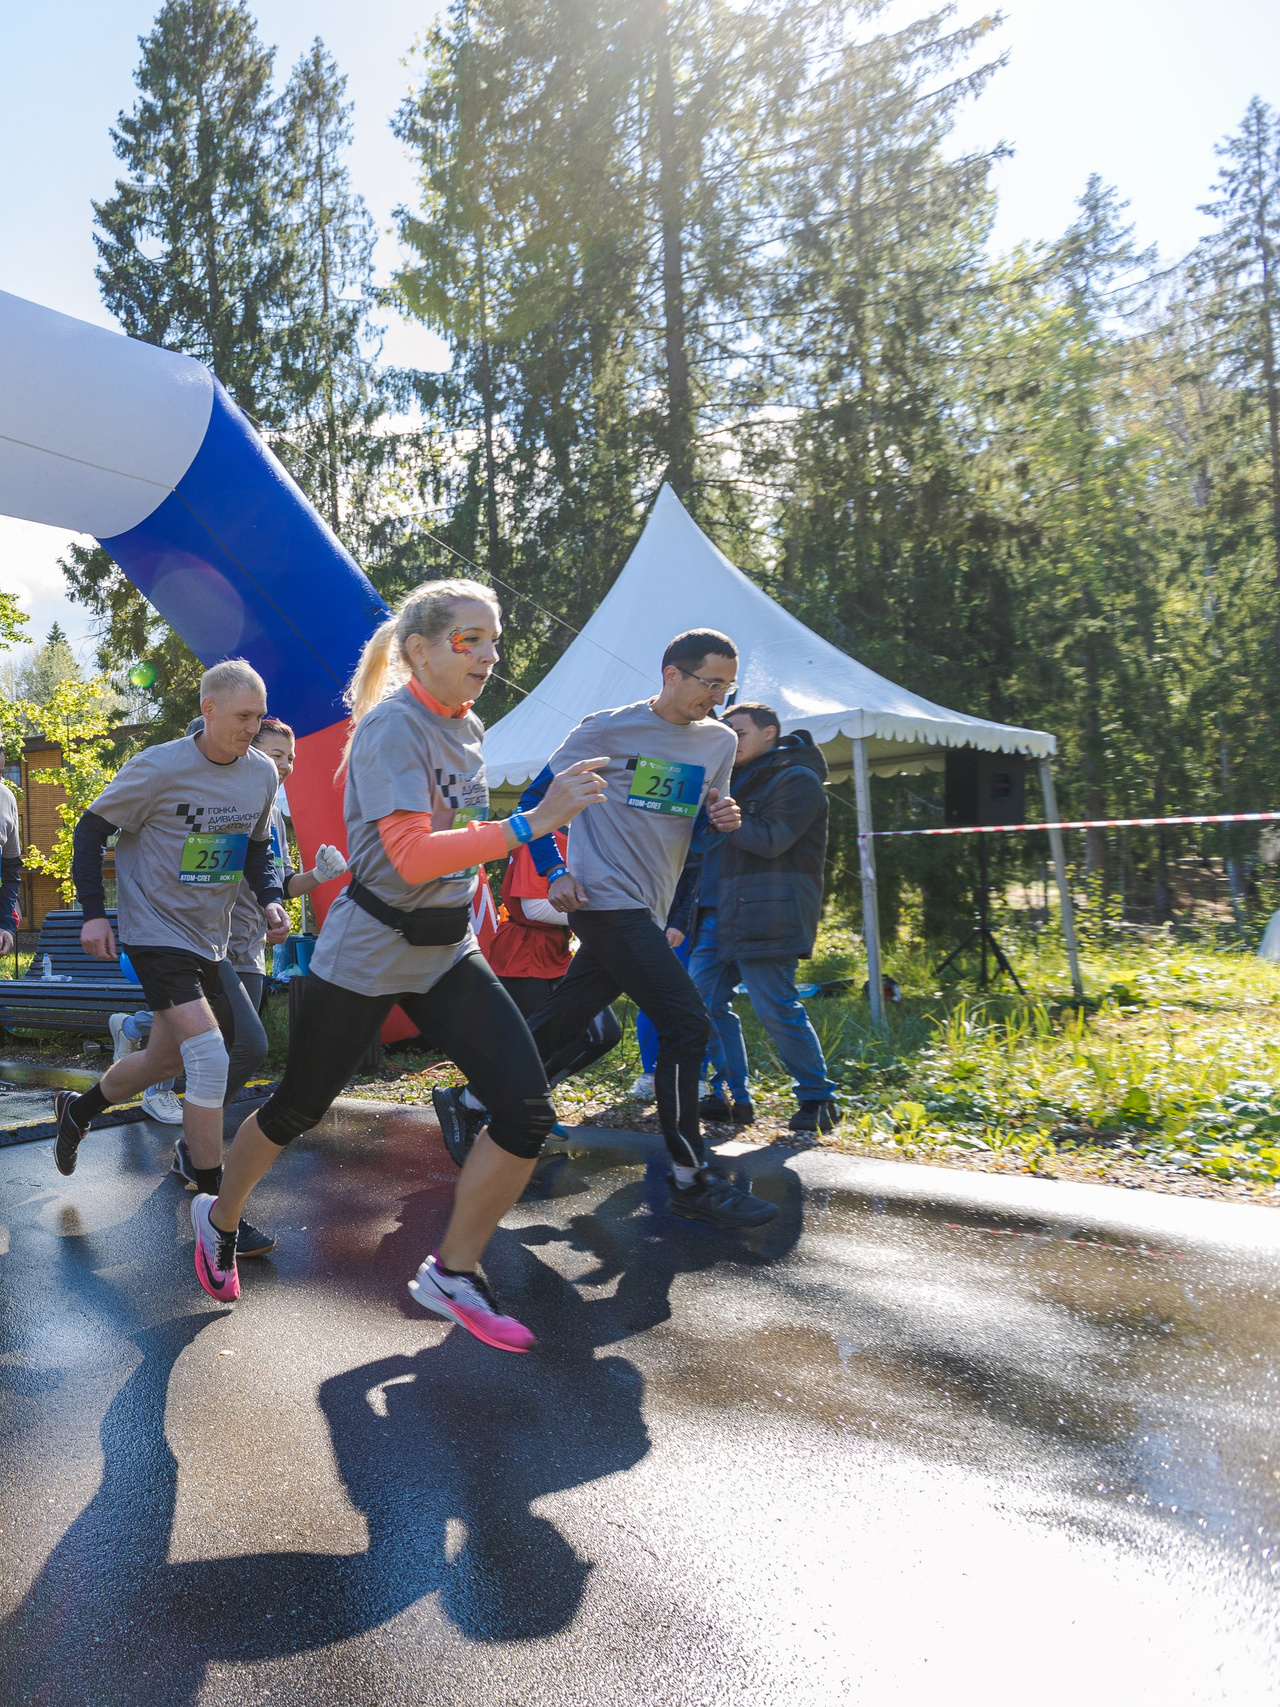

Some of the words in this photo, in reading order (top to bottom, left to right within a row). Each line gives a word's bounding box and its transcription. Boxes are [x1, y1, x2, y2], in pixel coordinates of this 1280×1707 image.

[645, 776, 685, 799] 251
[208, 806, 237, 814] ГОНКА
[208, 822, 252, 832] РОСАТОМА
[195, 850, 233, 869] 257
